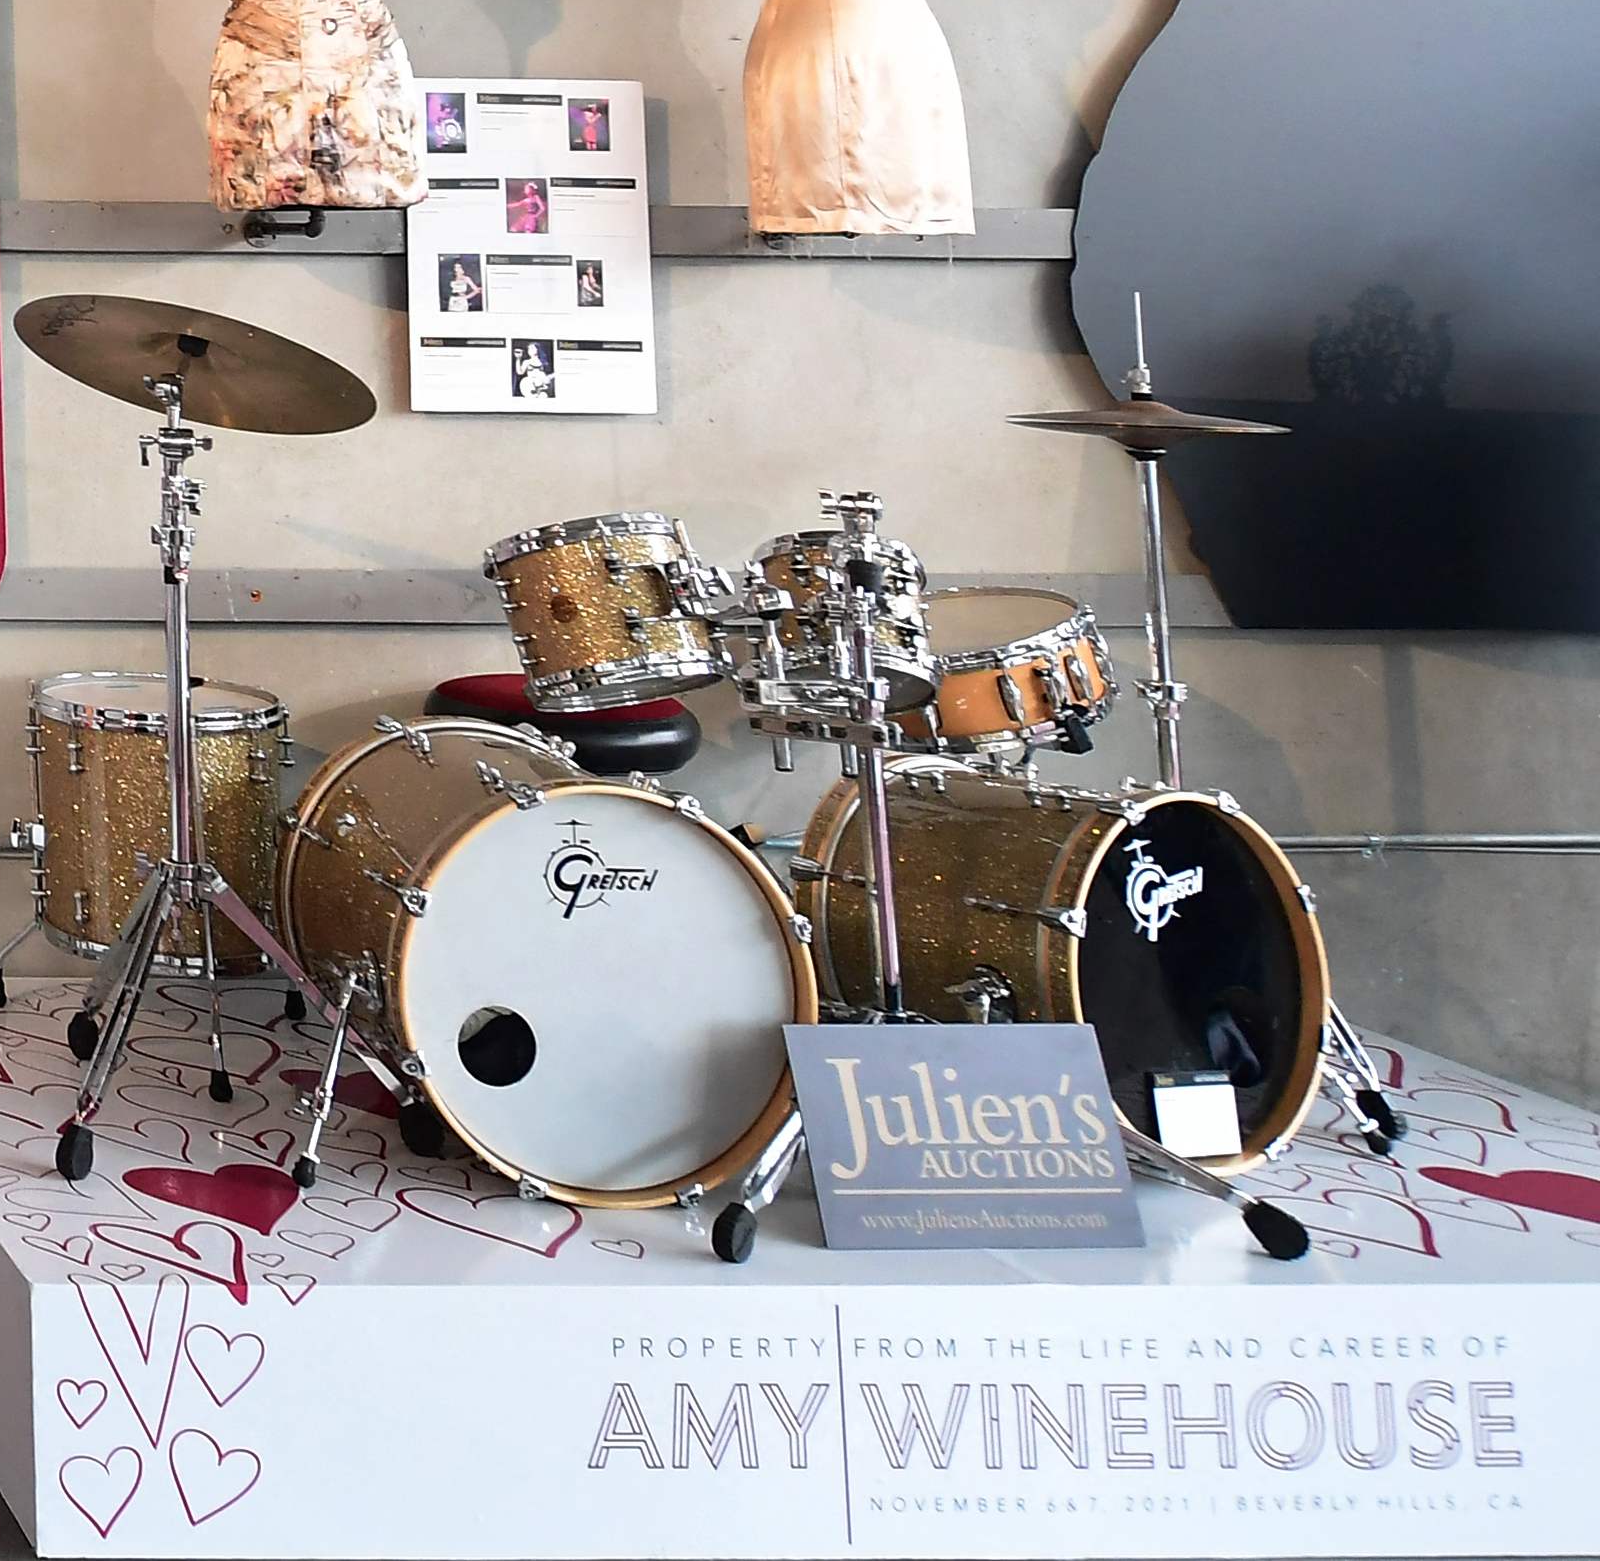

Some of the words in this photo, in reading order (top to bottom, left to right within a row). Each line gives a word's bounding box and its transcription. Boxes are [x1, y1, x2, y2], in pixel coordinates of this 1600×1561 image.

[825, 1058, 1108, 1180] Julien's
[920, 1149, 1115, 1180] AUCTIONS
[612, 1337, 825, 1359] PROPERTY
[854, 1338, 958, 1358] FROM
[984, 1338, 1052, 1358] THE
[1080, 1338, 1160, 1359] LIFE
[1186, 1338, 1263, 1359] AND
[1289, 1337, 1438, 1358] CAREER
[1463, 1336, 1509, 1358] OF
[587, 1383, 830, 1470] AMY
[859, 1379, 1524, 1471] WINEHOUSE
[869, 1495, 1028, 1514] NOVEMBER
[1124, 1495, 1191, 1513] 2021
[1236, 1494, 1358, 1512] BEVERLY
[1488, 1494, 1524, 1511] CA
